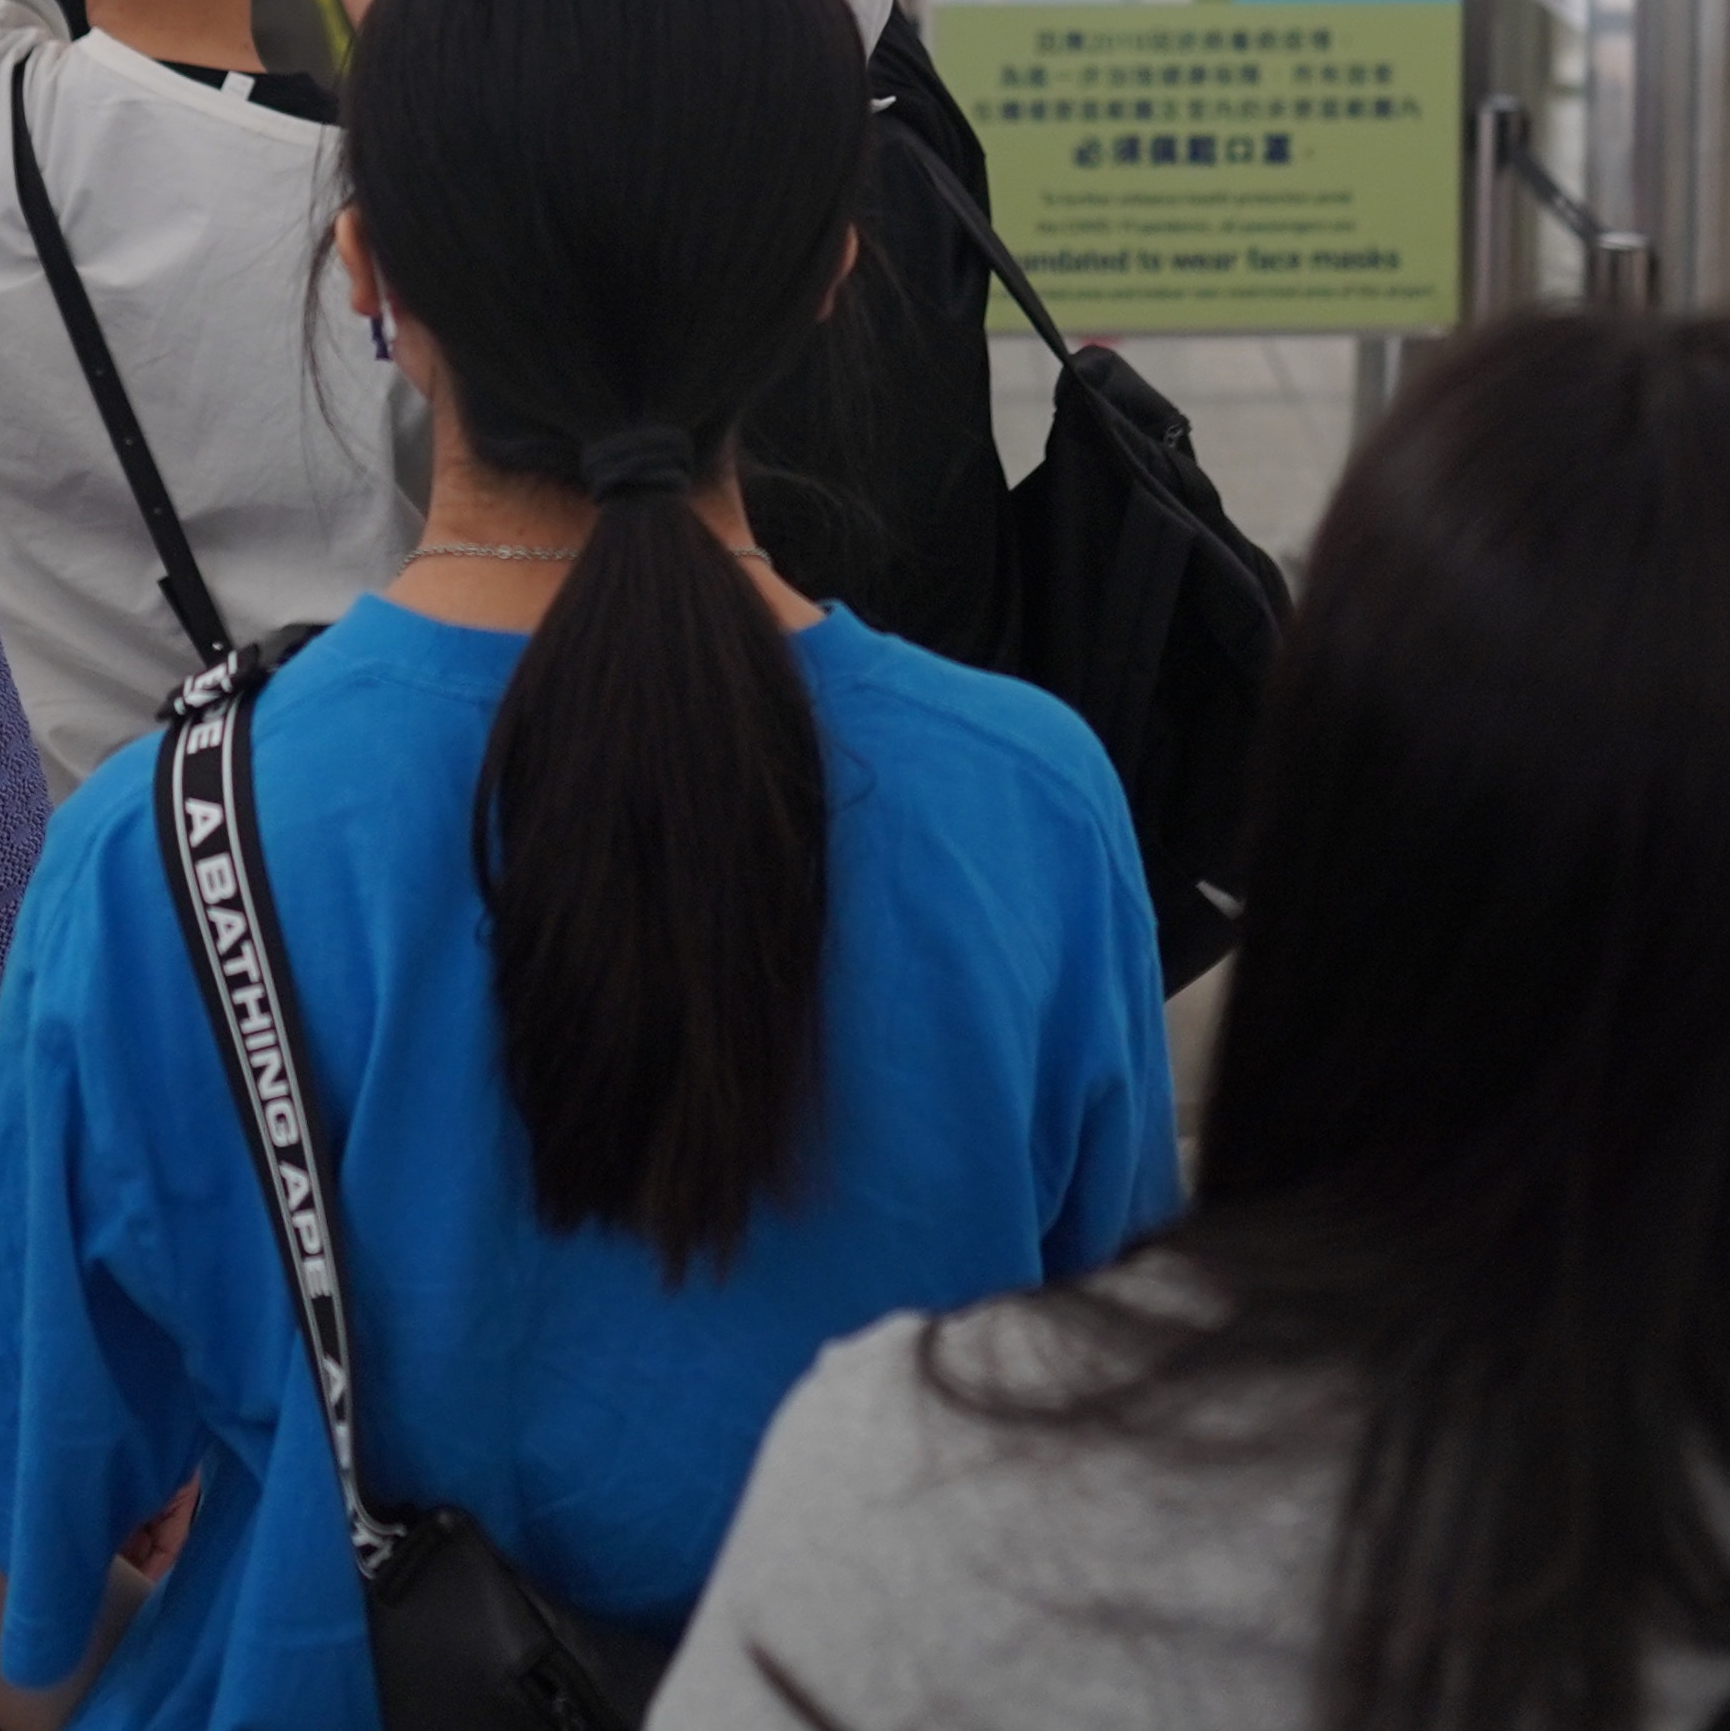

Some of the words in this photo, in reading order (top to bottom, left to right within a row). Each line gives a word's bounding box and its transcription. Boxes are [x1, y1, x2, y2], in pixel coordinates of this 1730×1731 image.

[184, 796, 225, 849] A
[194, 851, 301, 1148] BATHING
[277, 1159, 334, 1299] APE
